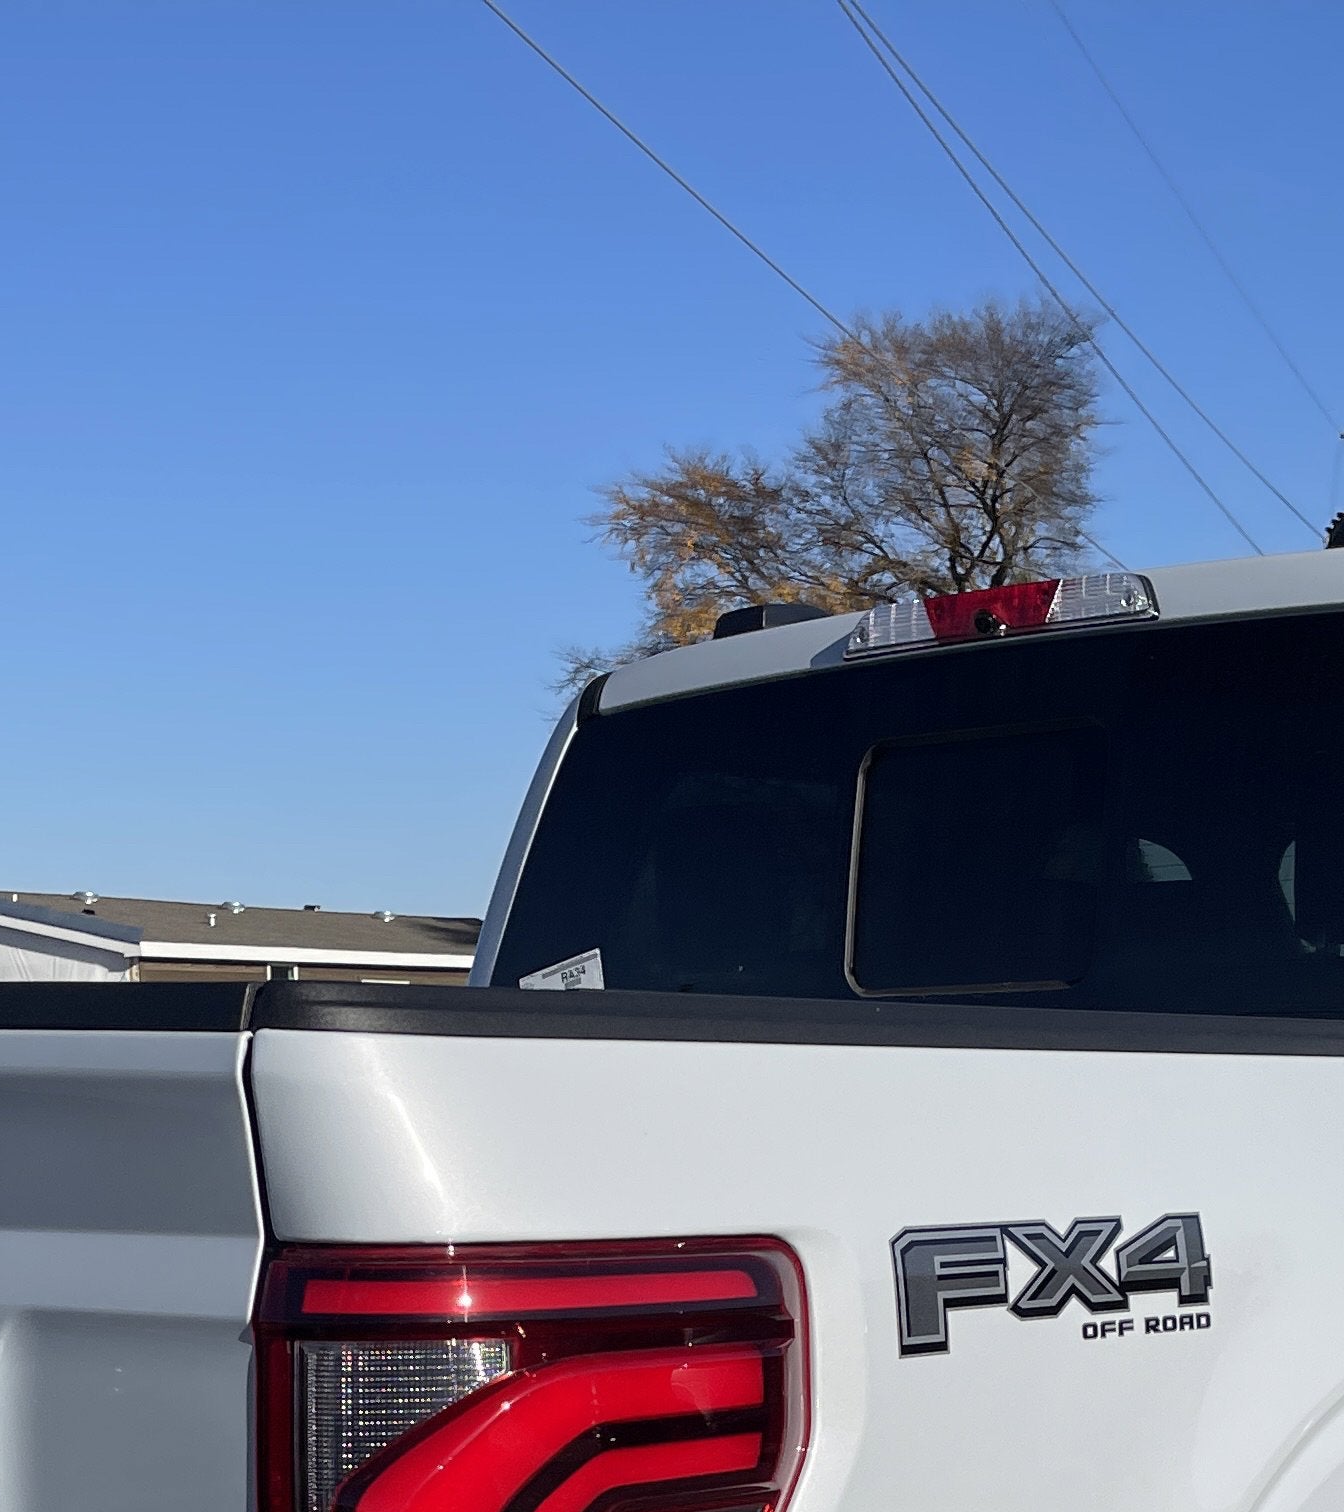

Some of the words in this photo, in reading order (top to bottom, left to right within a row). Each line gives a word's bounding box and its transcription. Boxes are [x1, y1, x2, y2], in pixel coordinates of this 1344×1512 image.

[889, 1211, 1213, 1359] FX4
[1082, 1318, 1134, 1340] OFF
[1144, 1312, 1212, 1334] ROAD
